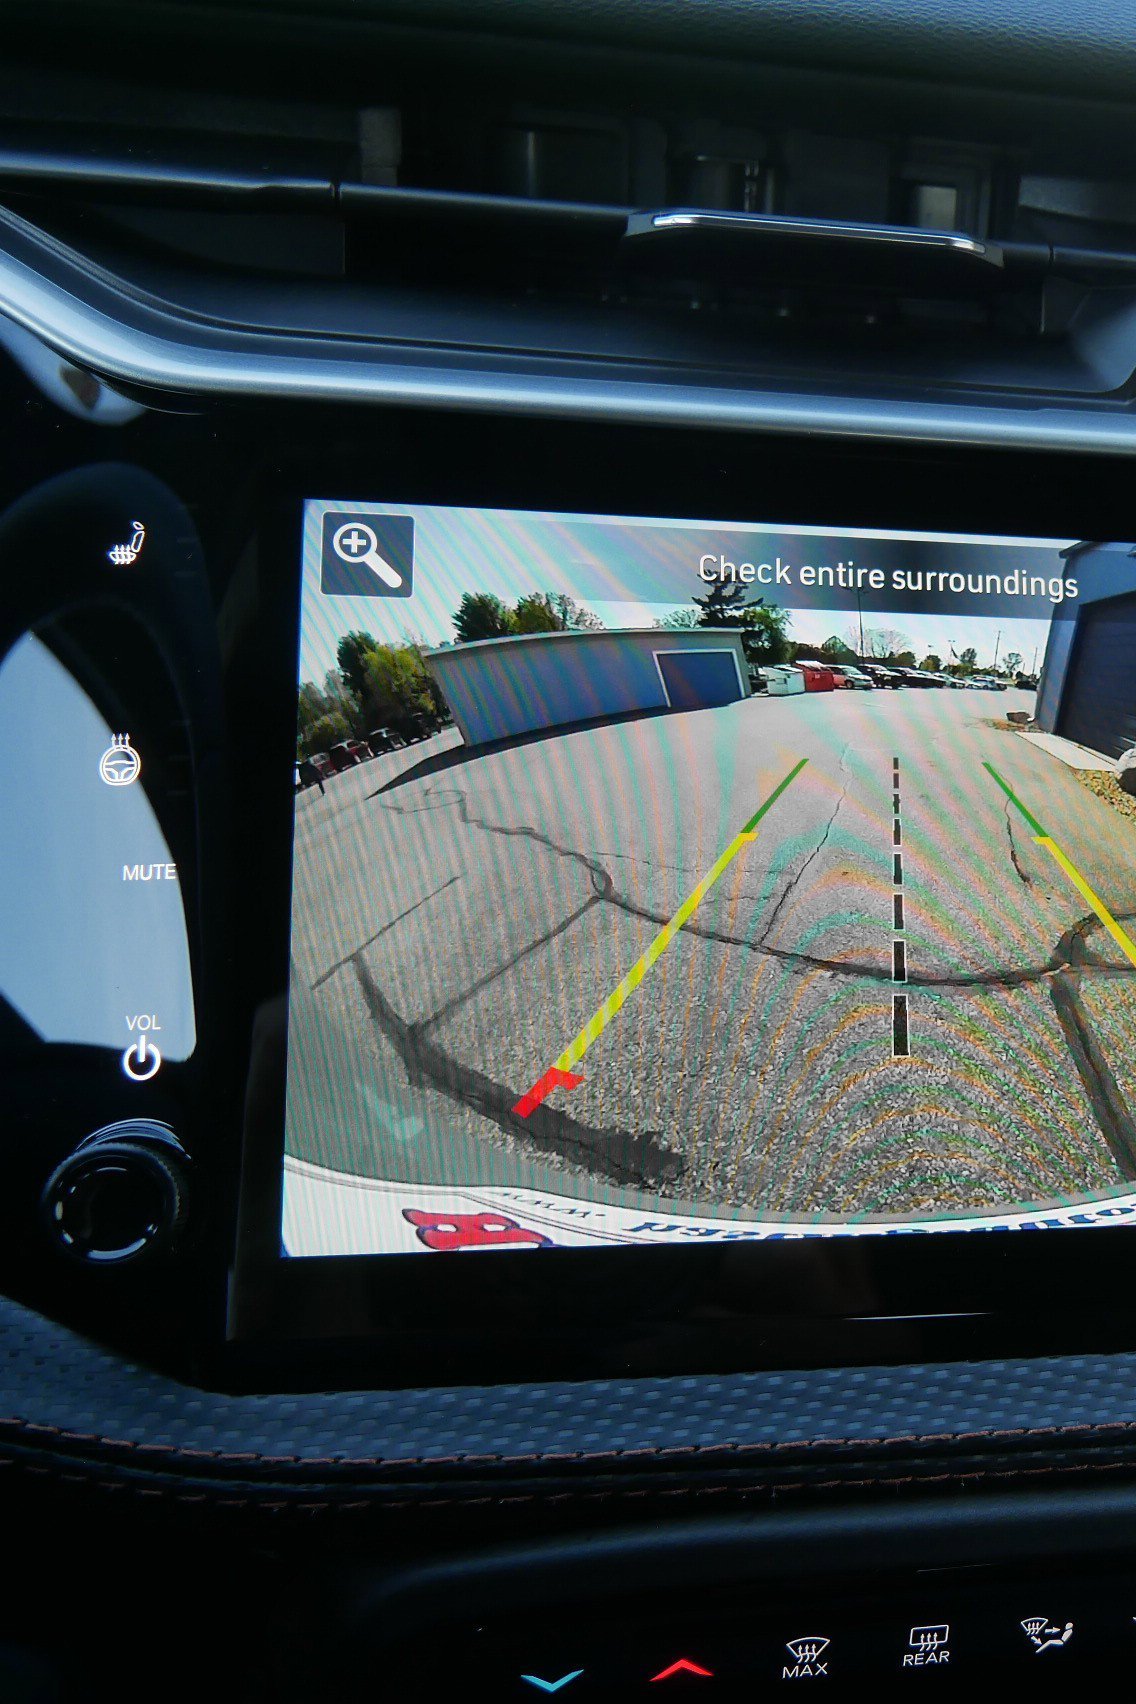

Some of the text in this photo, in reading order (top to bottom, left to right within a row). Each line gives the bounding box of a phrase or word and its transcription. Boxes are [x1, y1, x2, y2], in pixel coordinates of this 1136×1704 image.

[699, 554, 1079, 604] Check entire surroundings
[122, 863, 177, 881] MUTE
[125, 1014, 162, 1031] VOL
[902, 1650, 950, 1667] REAR
[782, 1662, 829, 1679] MAX
